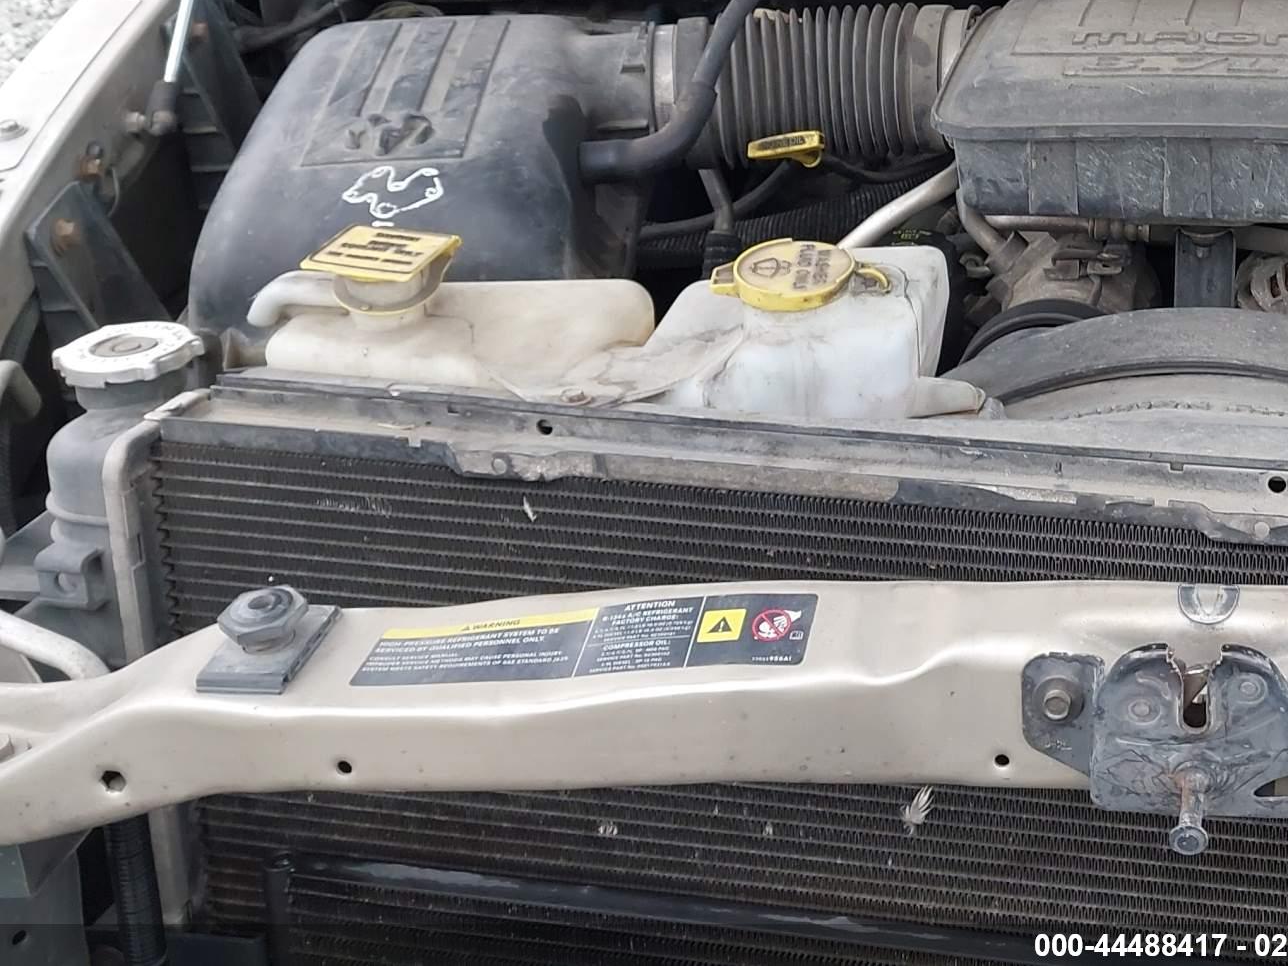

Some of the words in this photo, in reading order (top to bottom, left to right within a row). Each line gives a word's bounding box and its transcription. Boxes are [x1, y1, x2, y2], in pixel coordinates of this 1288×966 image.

[624, 600, 676, 611] ATTENTION
[642, 607, 694, 616] REFRIGERANT
[472, 619, 521, 630] WARNING
[447, 633, 503, 643] REFRIGERANT
[503, 630, 536, 638] SYSTEM
[429, 642, 472, 651] QUALIFIED
[473, 638, 521, 647] PERSONNEL
[603, 641, 655, 651] COMPRESSOR
